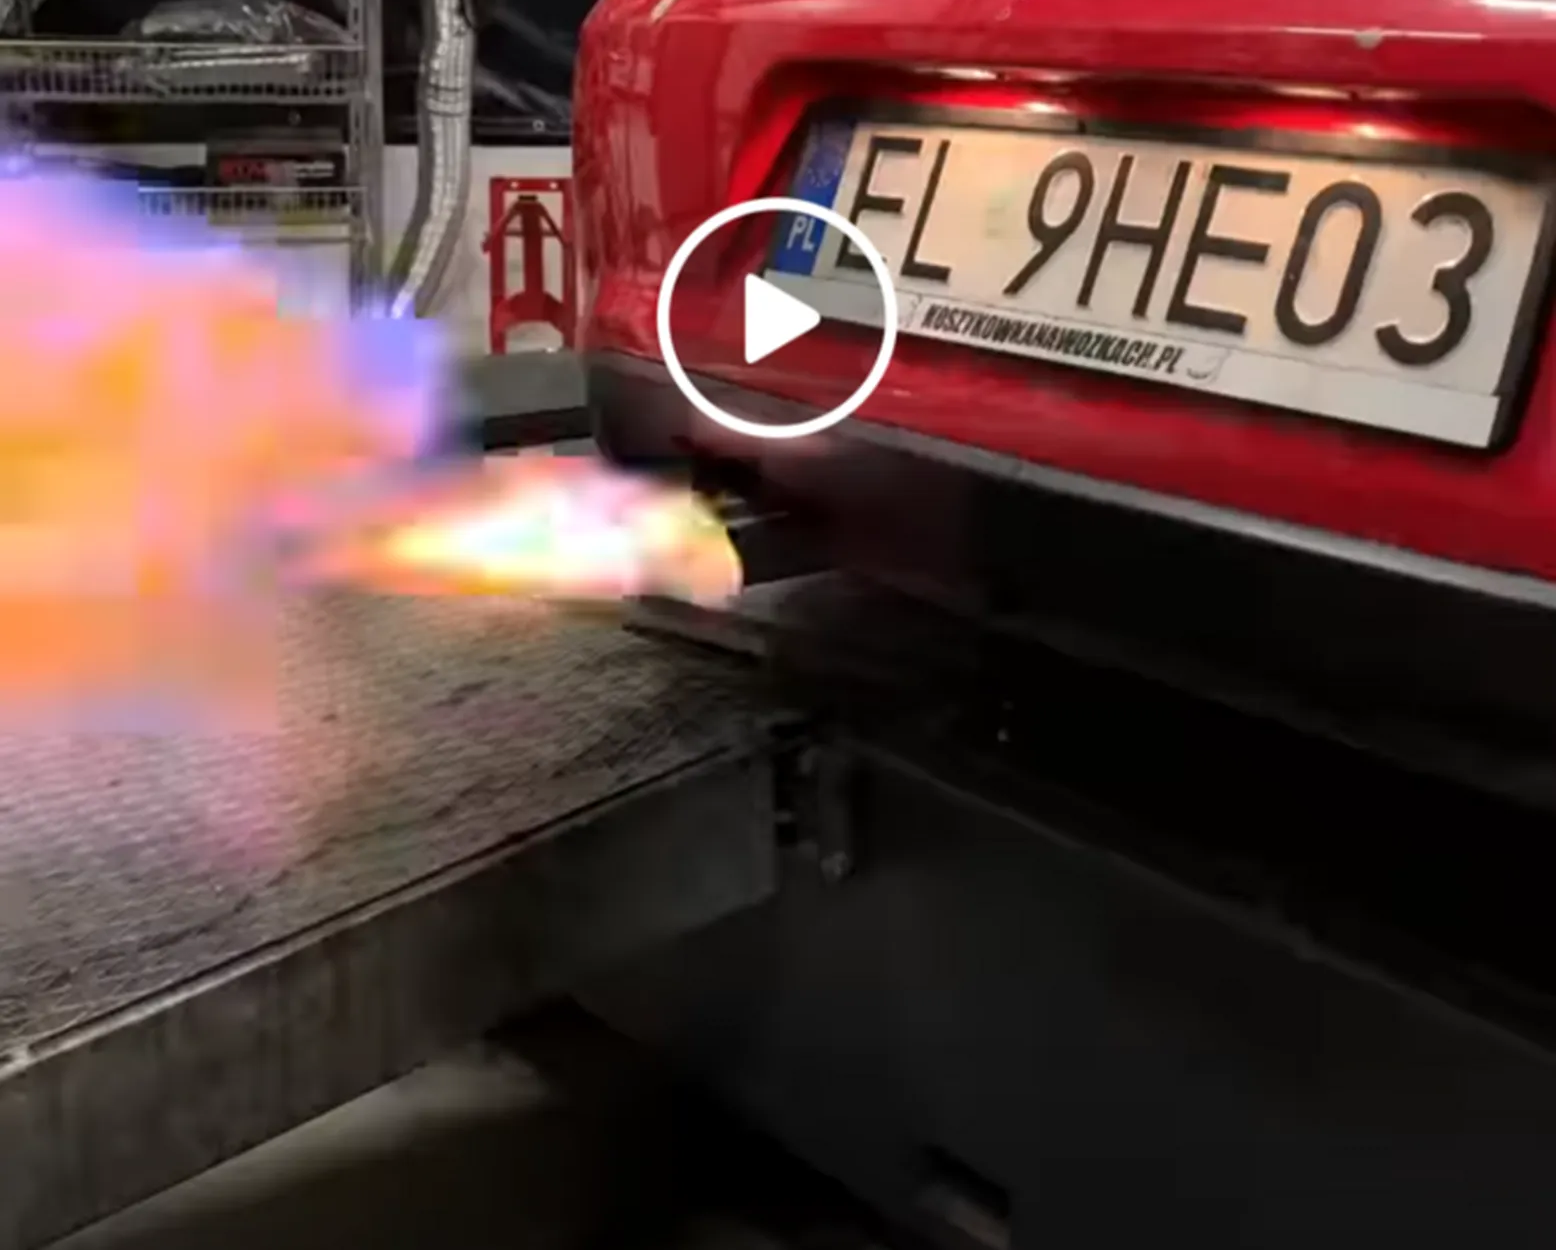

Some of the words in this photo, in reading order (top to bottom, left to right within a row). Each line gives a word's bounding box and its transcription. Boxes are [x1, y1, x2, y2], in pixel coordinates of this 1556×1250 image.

[786, 215, 817, 251] PL
[835, 135, 952, 283] EL
[1003, 151, 1495, 367] 9HE03
